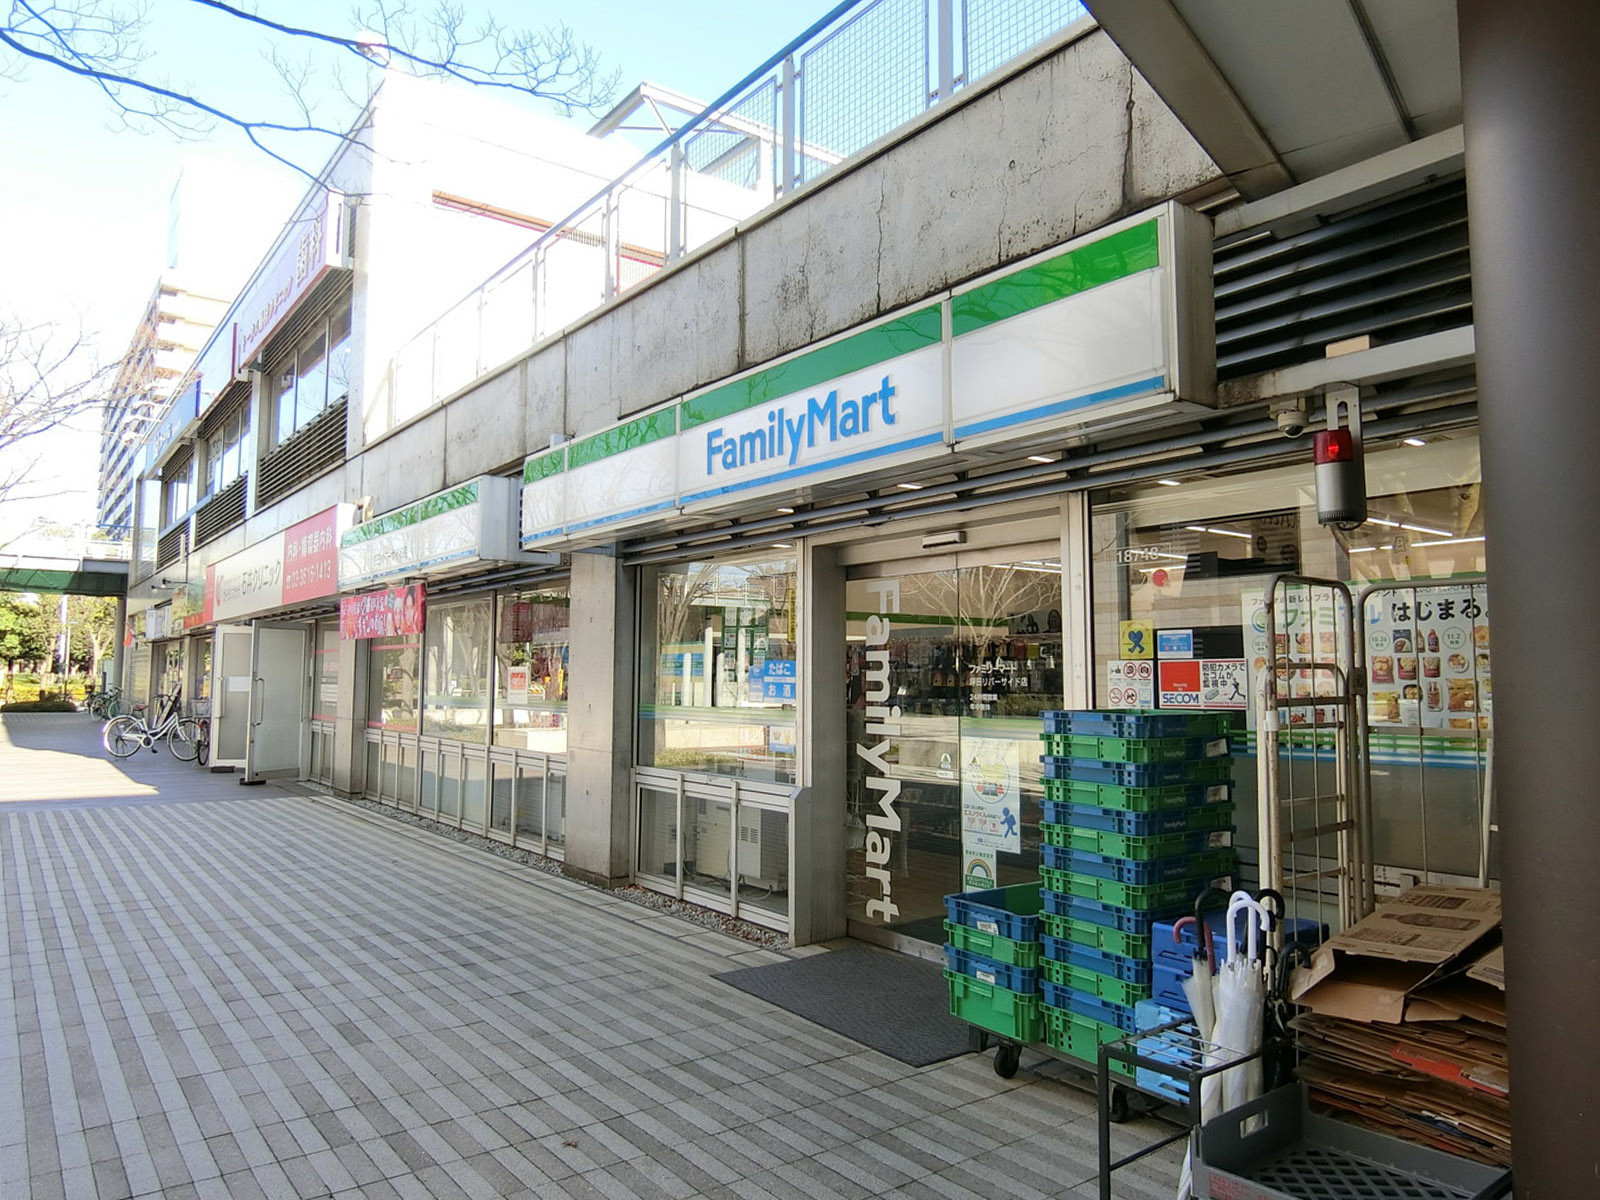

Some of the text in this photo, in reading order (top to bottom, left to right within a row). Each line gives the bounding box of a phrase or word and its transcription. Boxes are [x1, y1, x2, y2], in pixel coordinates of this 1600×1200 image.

[707, 375, 896, 475] FamilyMart
[768, 663, 792, 675] たばこ
[968, 662, 1017, 674] ファミリーマート
[1202, 662, 1246, 672] 防犯カメラで
[1203, 671, 1234, 680] セコムが
[1203, 679, 1228, 688] 監視中
[768, 684, 792, 697] お酒
[1162, 693, 1199, 704] SECOM
[856, 578, 902, 923] FamilyMart
